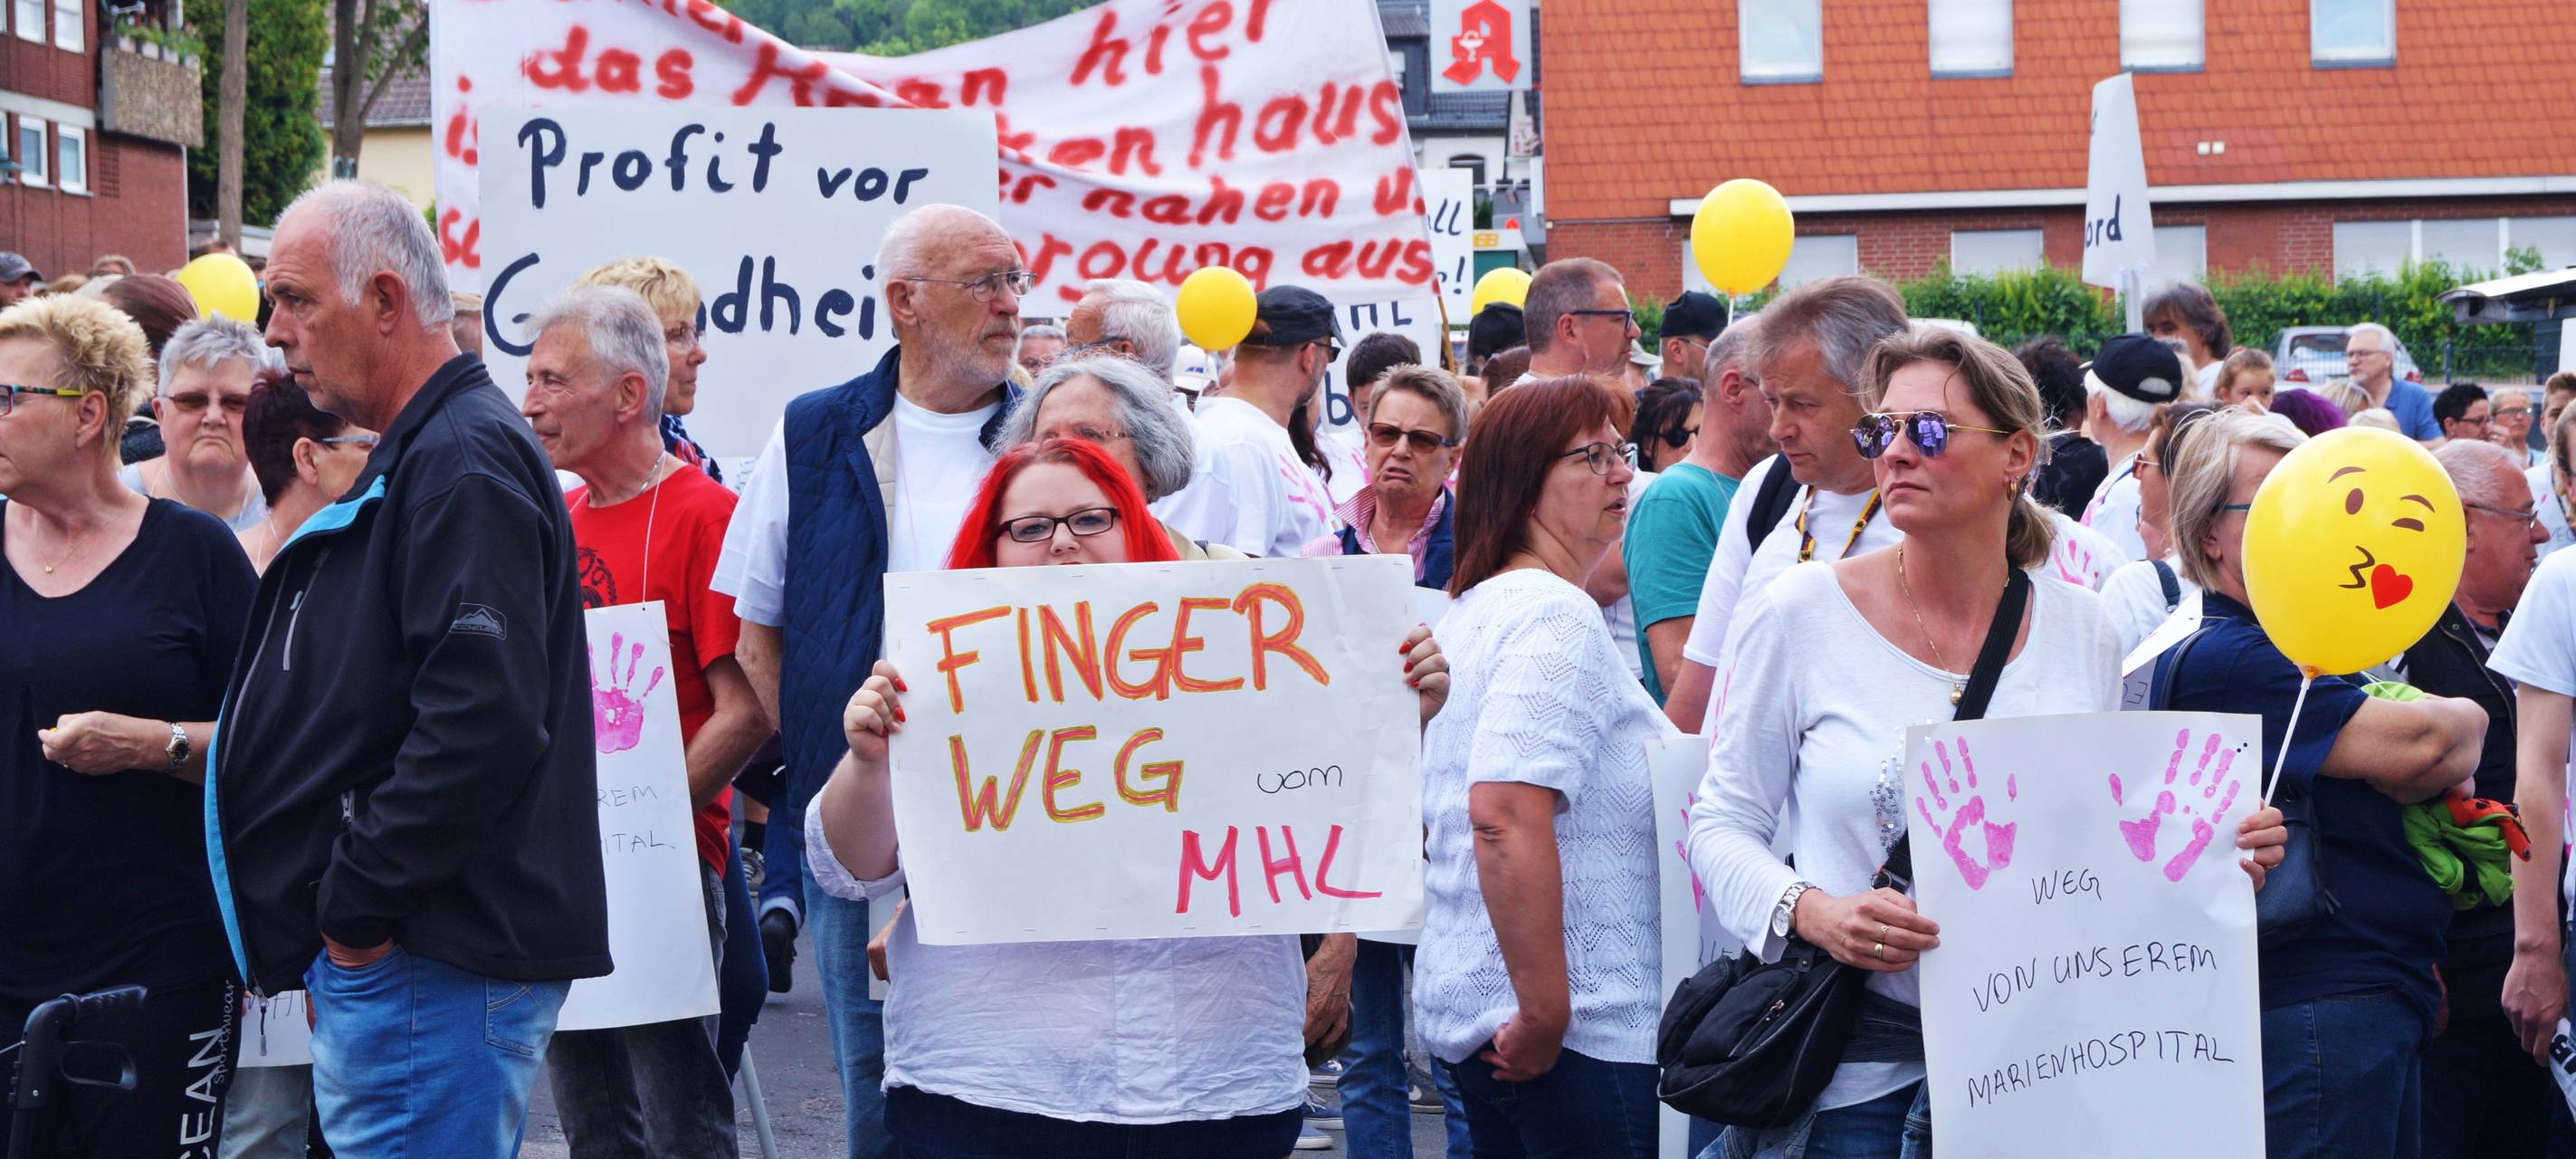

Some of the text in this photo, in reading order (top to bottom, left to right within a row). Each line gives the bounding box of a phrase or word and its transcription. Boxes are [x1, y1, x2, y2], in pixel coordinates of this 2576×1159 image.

[522, 24, 696, 101] das
[518, 117, 929, 208] Profit vor
[1082, 175, 1340, 225] nahen
[926, 581, 1331, 715] FINGER
[948, 724, 1184, 832] WEG
[1176, 825, 1383, 917] MHL
[2031, 868, 2103, 905] WEG
[1972, 956, 2037, 1012] VON
[1968, 1030, 2235, 1108] MARIENHOSPITAL
